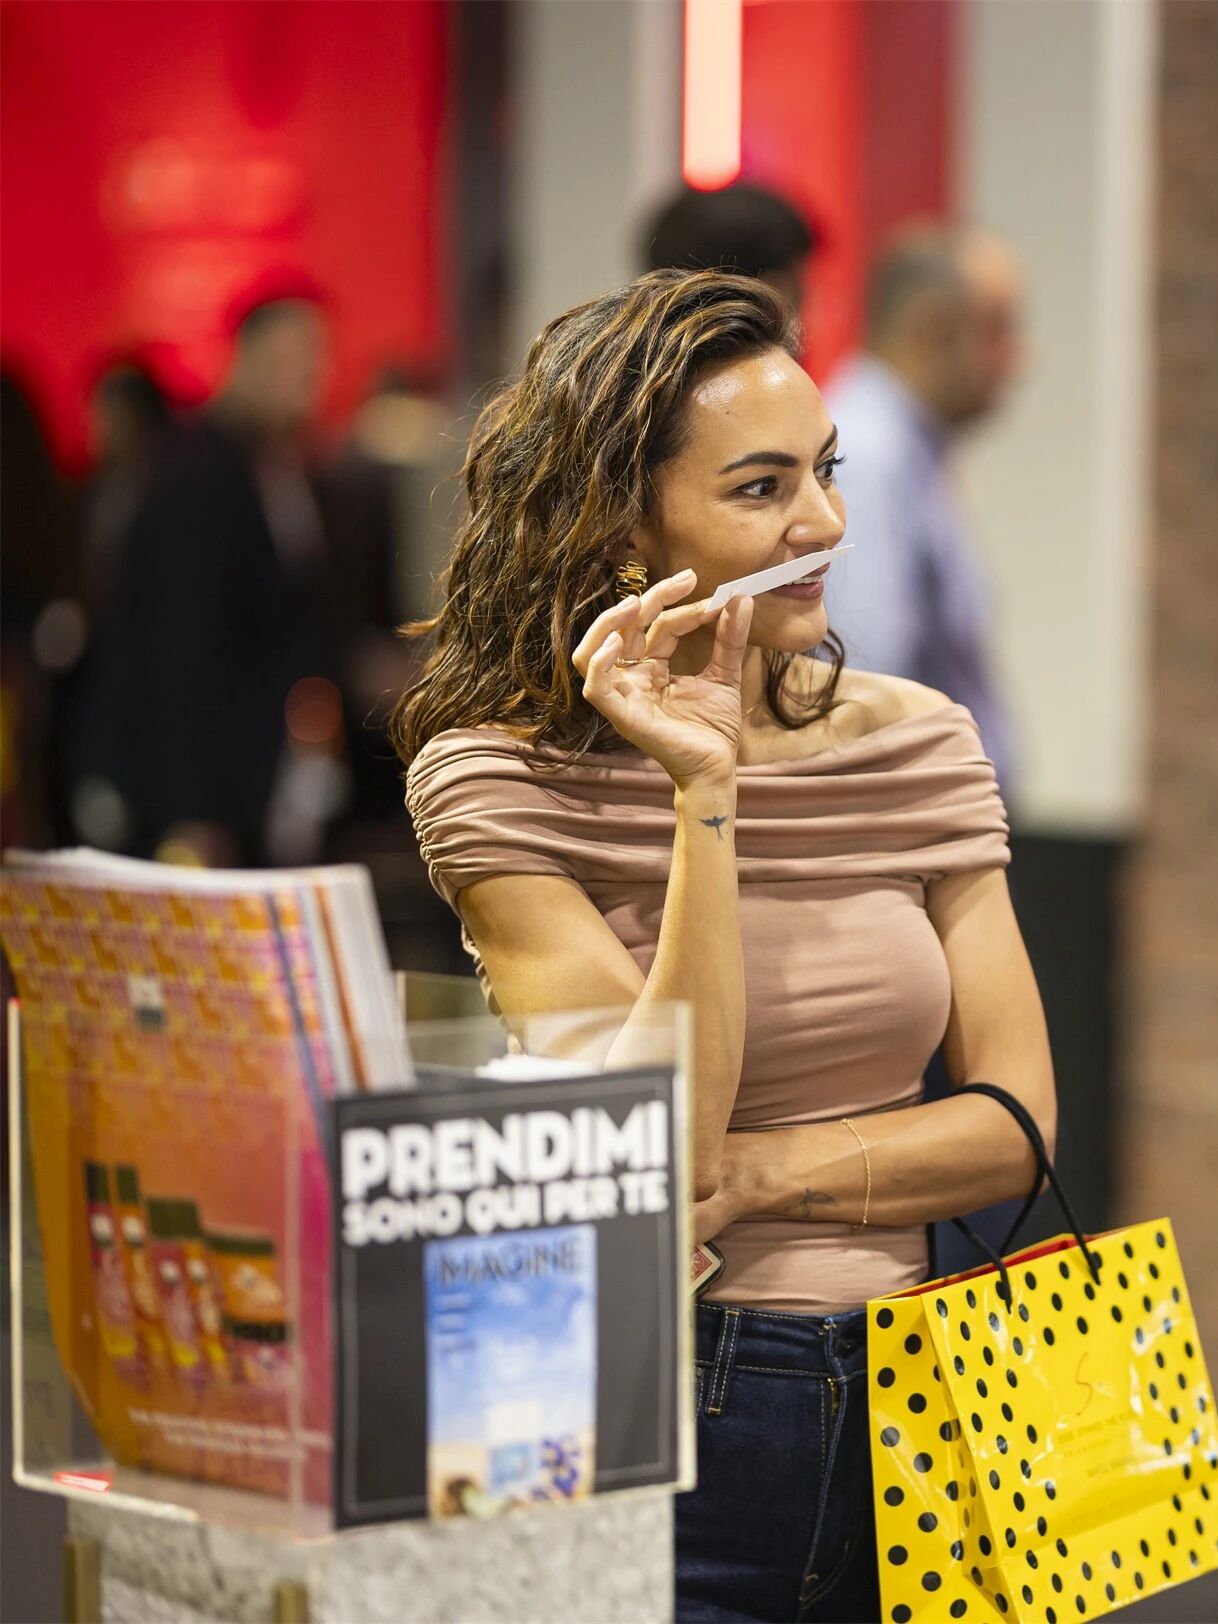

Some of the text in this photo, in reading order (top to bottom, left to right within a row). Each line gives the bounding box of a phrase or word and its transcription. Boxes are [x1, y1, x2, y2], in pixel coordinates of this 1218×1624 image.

[341, 1100, 668, 1200] PRENDIMI
[343, 1169, 669, 1246] SONO QUI PER TE
[433, 1241, 579, 1287] IMAGINE
